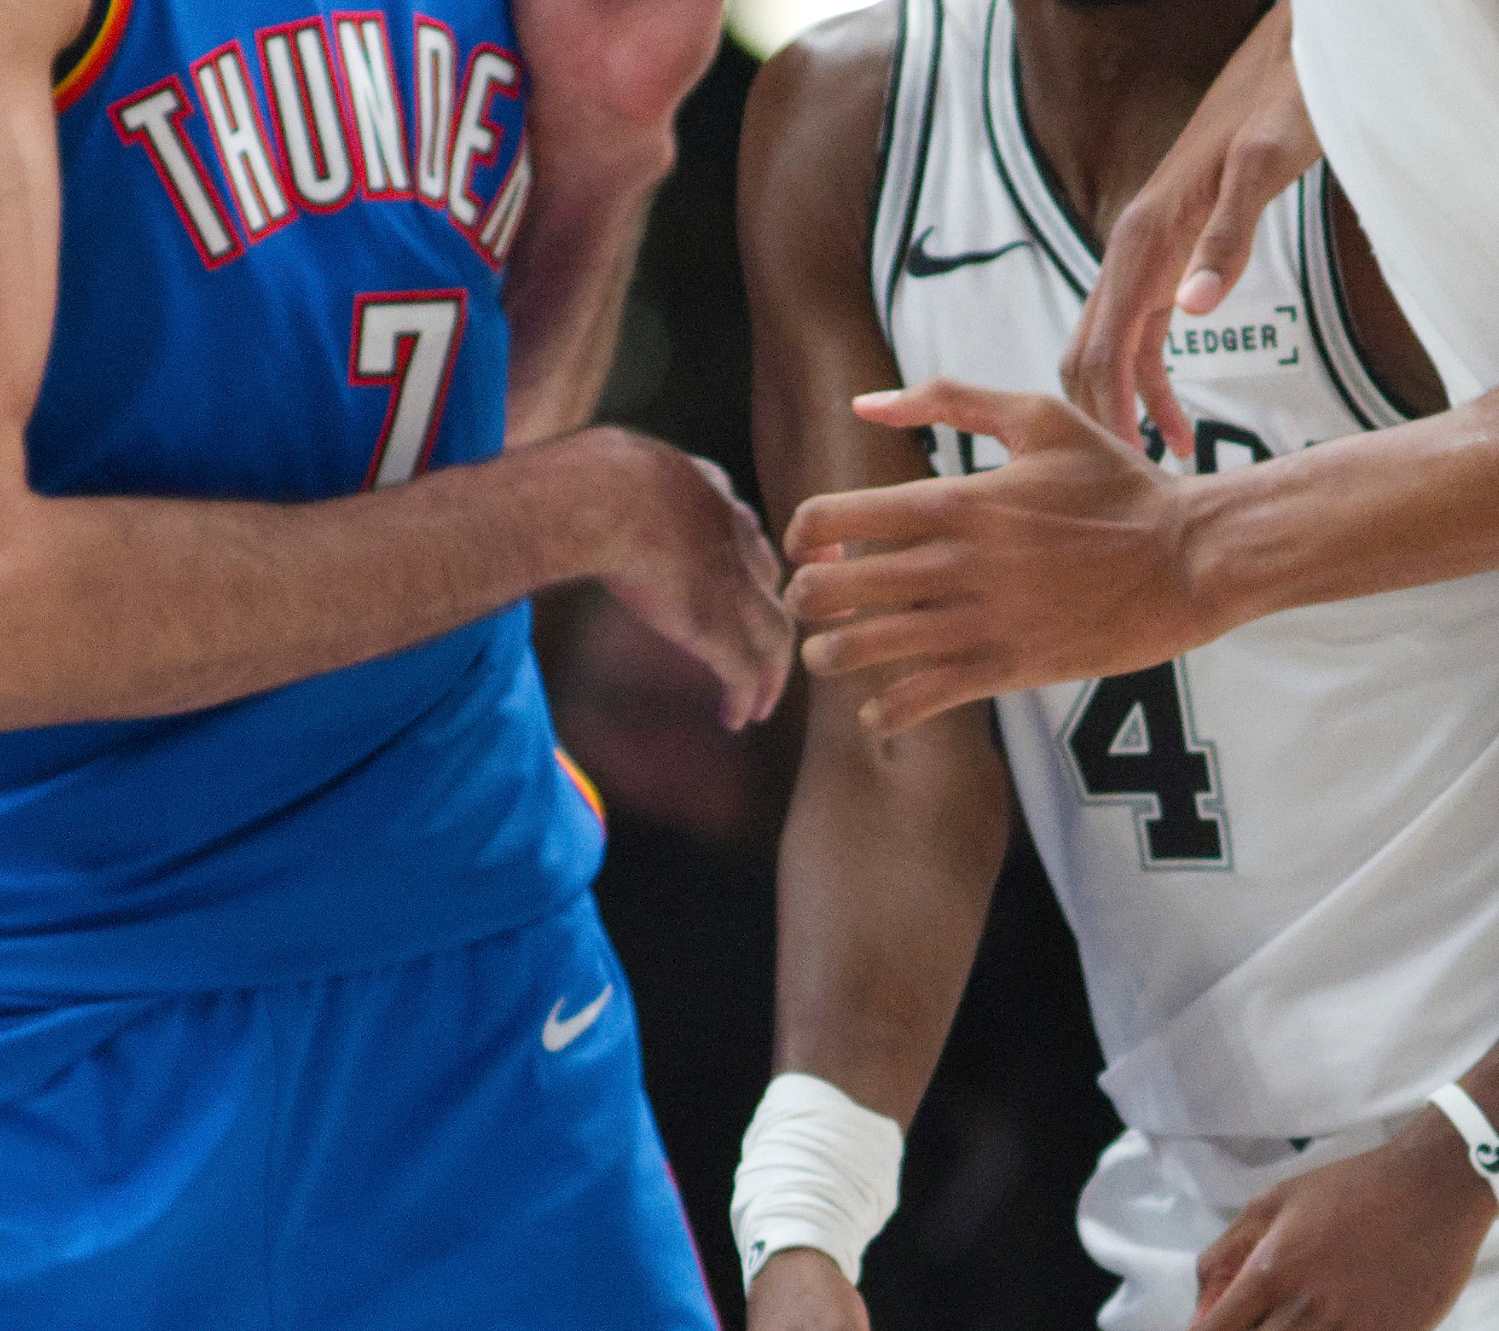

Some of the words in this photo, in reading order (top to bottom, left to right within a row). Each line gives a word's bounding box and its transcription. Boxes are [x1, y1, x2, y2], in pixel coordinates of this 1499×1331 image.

[349, 288, 468, 492] 7
[1170, 324, 1278, 355] LEDGER
[1059, 657, 1235, 872] 4
